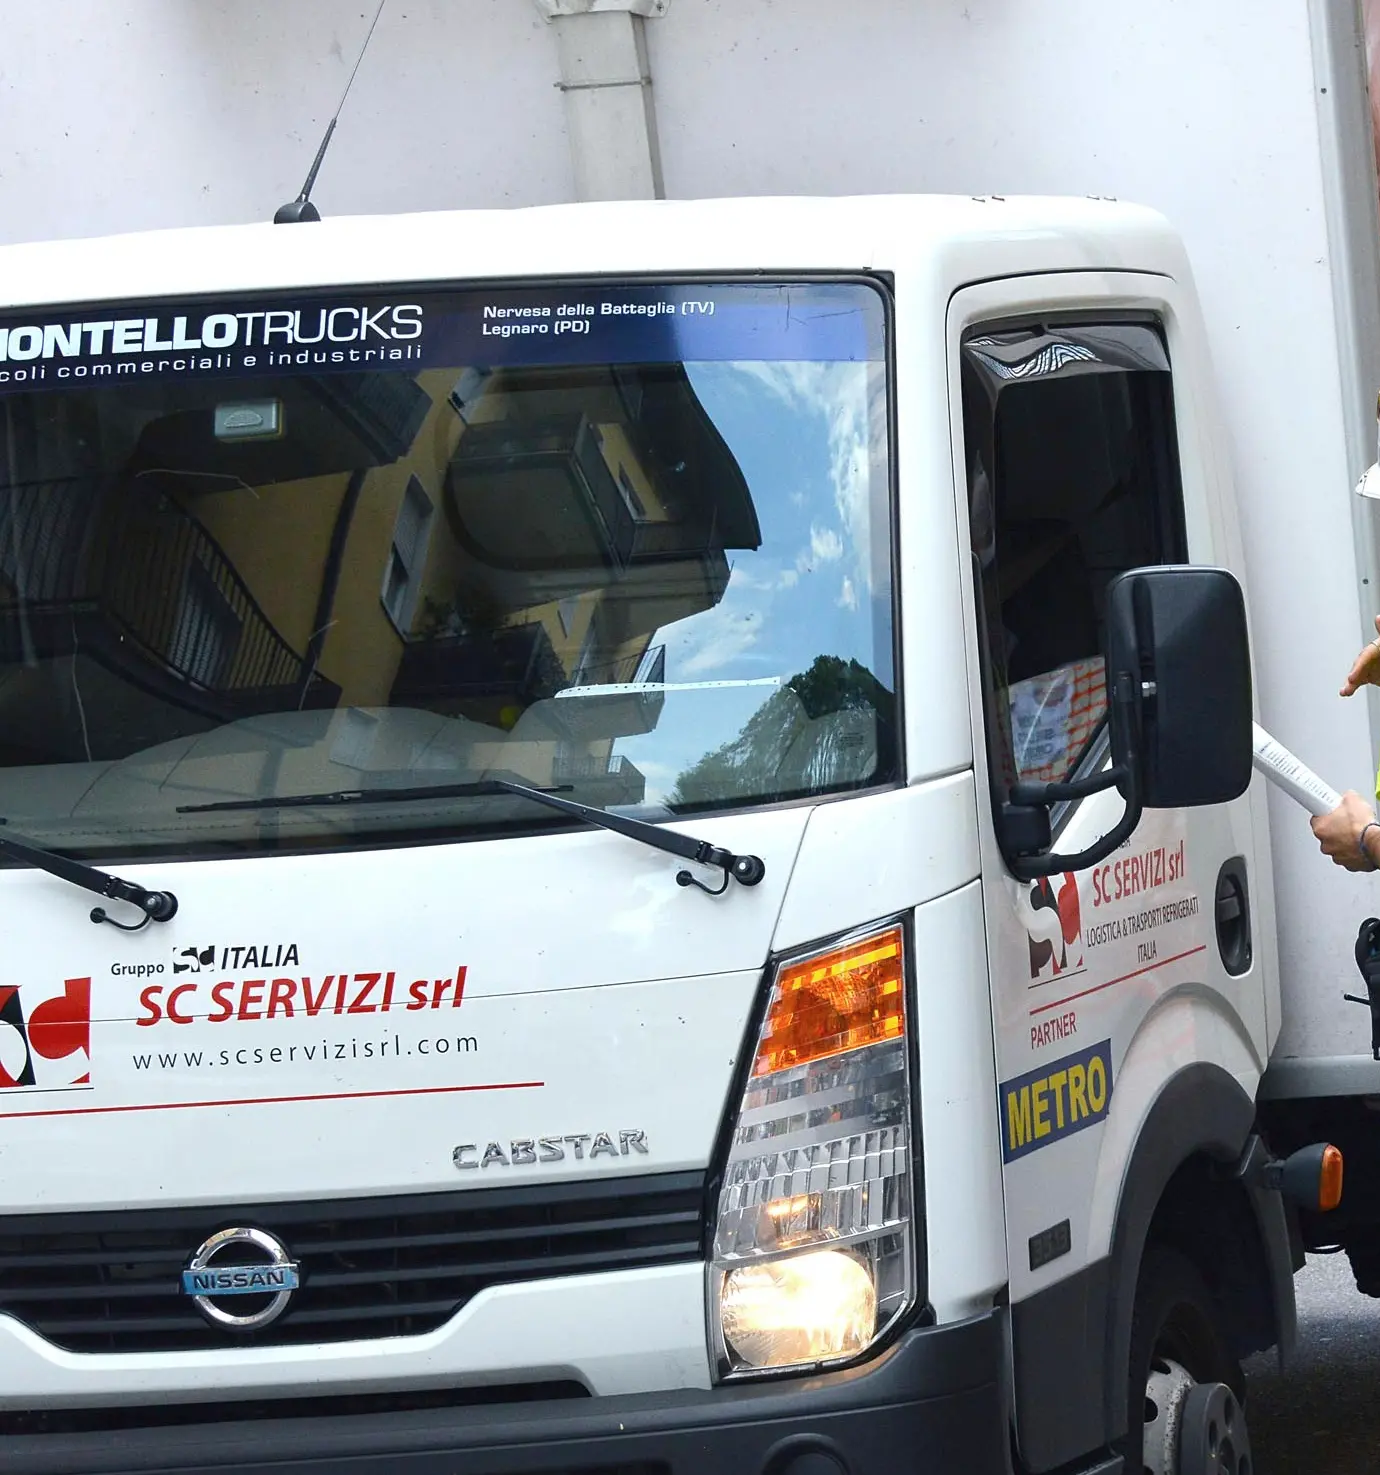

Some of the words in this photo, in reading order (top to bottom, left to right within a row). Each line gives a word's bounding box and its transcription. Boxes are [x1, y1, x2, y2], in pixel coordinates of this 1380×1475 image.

[483, 306, 551, 318] Nervesa
[556, 304, 595, 316] della
[601, 302, 675, 317] Battaglia
[681, 301, 715, 316] (TV)
[482, 322, 548, 337] Legnaro
[554, 320, 590, 335] (PD)
[57, 351, 231, 378] commerciali
[243, 354, 257, 367] e
[269, 345, 422, 366] industriali
[1092, 865, 1112, 907] SC
[1114, 847, 1166, 900] SERVIZI
[1168, 840, 1184, 882] srl
[1086, 920, 1122, 948] LOGISTICA
[1122, 918, 1128, 936] &
[1128, 907, 1162, 935] TRASPORTI
[1162, 896, 1199, 924] REFRIGERATI
[111, 961, 165, 978] Gruppo
[221, 944, 300, 970] ITALIA
[1137, 940, 1157, 963] ITALIA
[136, 983, 198, 1027] SC
[207, 972, 396, 1023] SERVIZI
[406, 966, 468, 1011] srl
[1030, 1012, 1077, 1049] PARTNER
[133, 1034, 479, 1070] www.scservizisrl.com
[1007, 1055, 1107, 1151] METRO
[452, 1128, 649, 1170] CABSTAR
[193, 1270, 285, 1289] NISSAN
